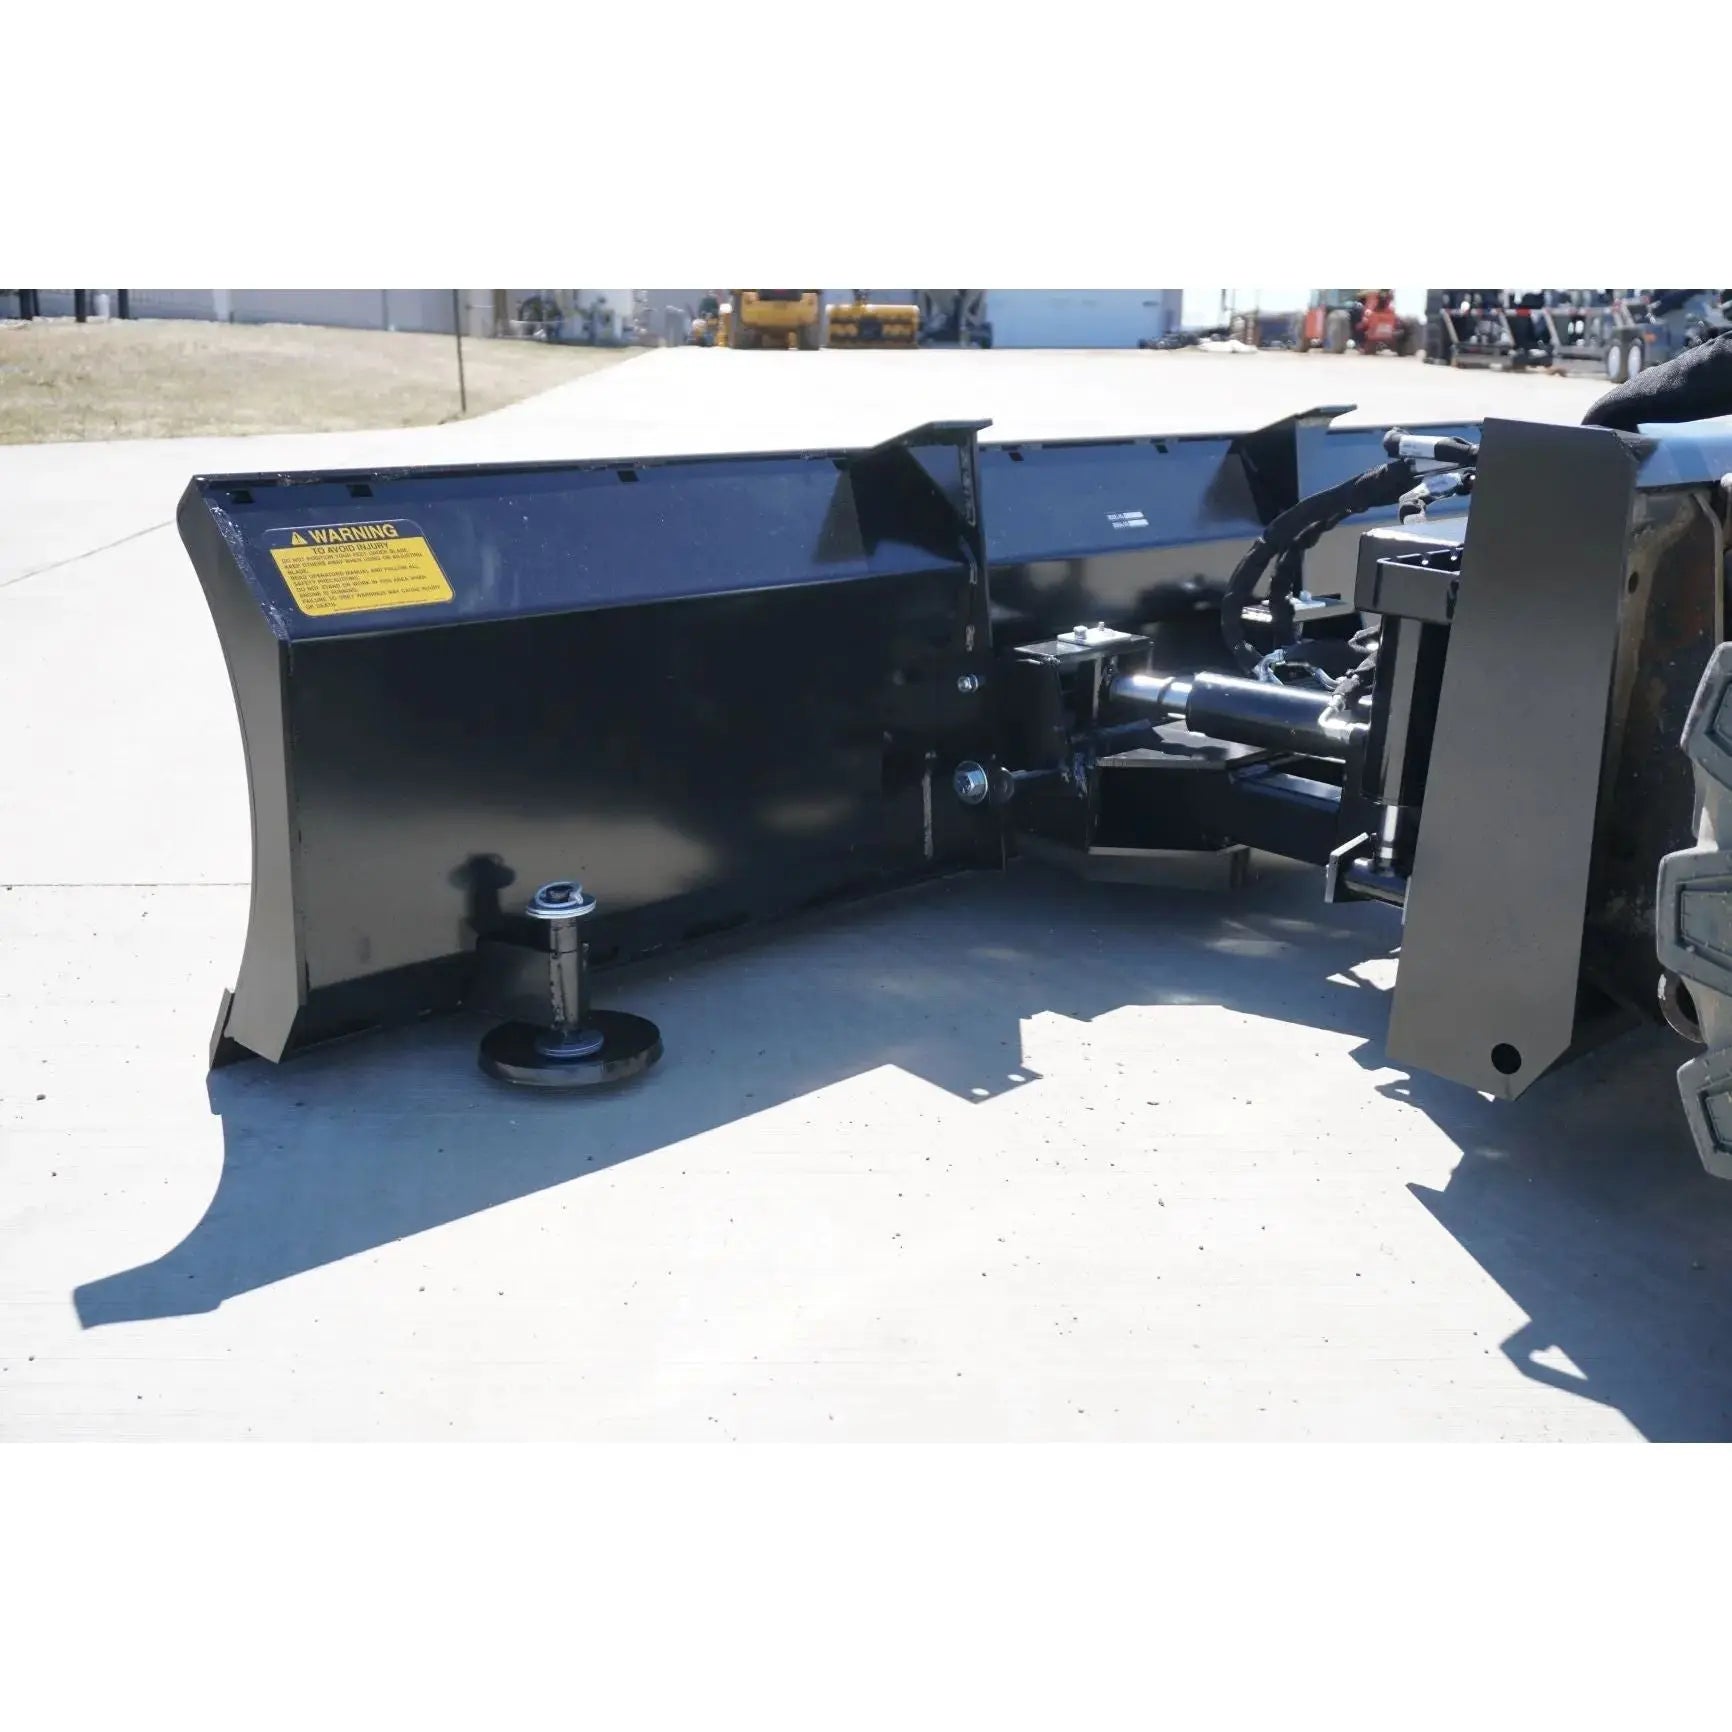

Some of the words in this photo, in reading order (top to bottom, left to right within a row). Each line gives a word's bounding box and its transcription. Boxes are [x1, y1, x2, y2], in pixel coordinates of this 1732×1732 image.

[308, 524, 398, 543] WARNING
[312, 546, 325, 554] TO
[327, 544, 354, 554] AVOID
[356, 542, 388, 551] INJURY
